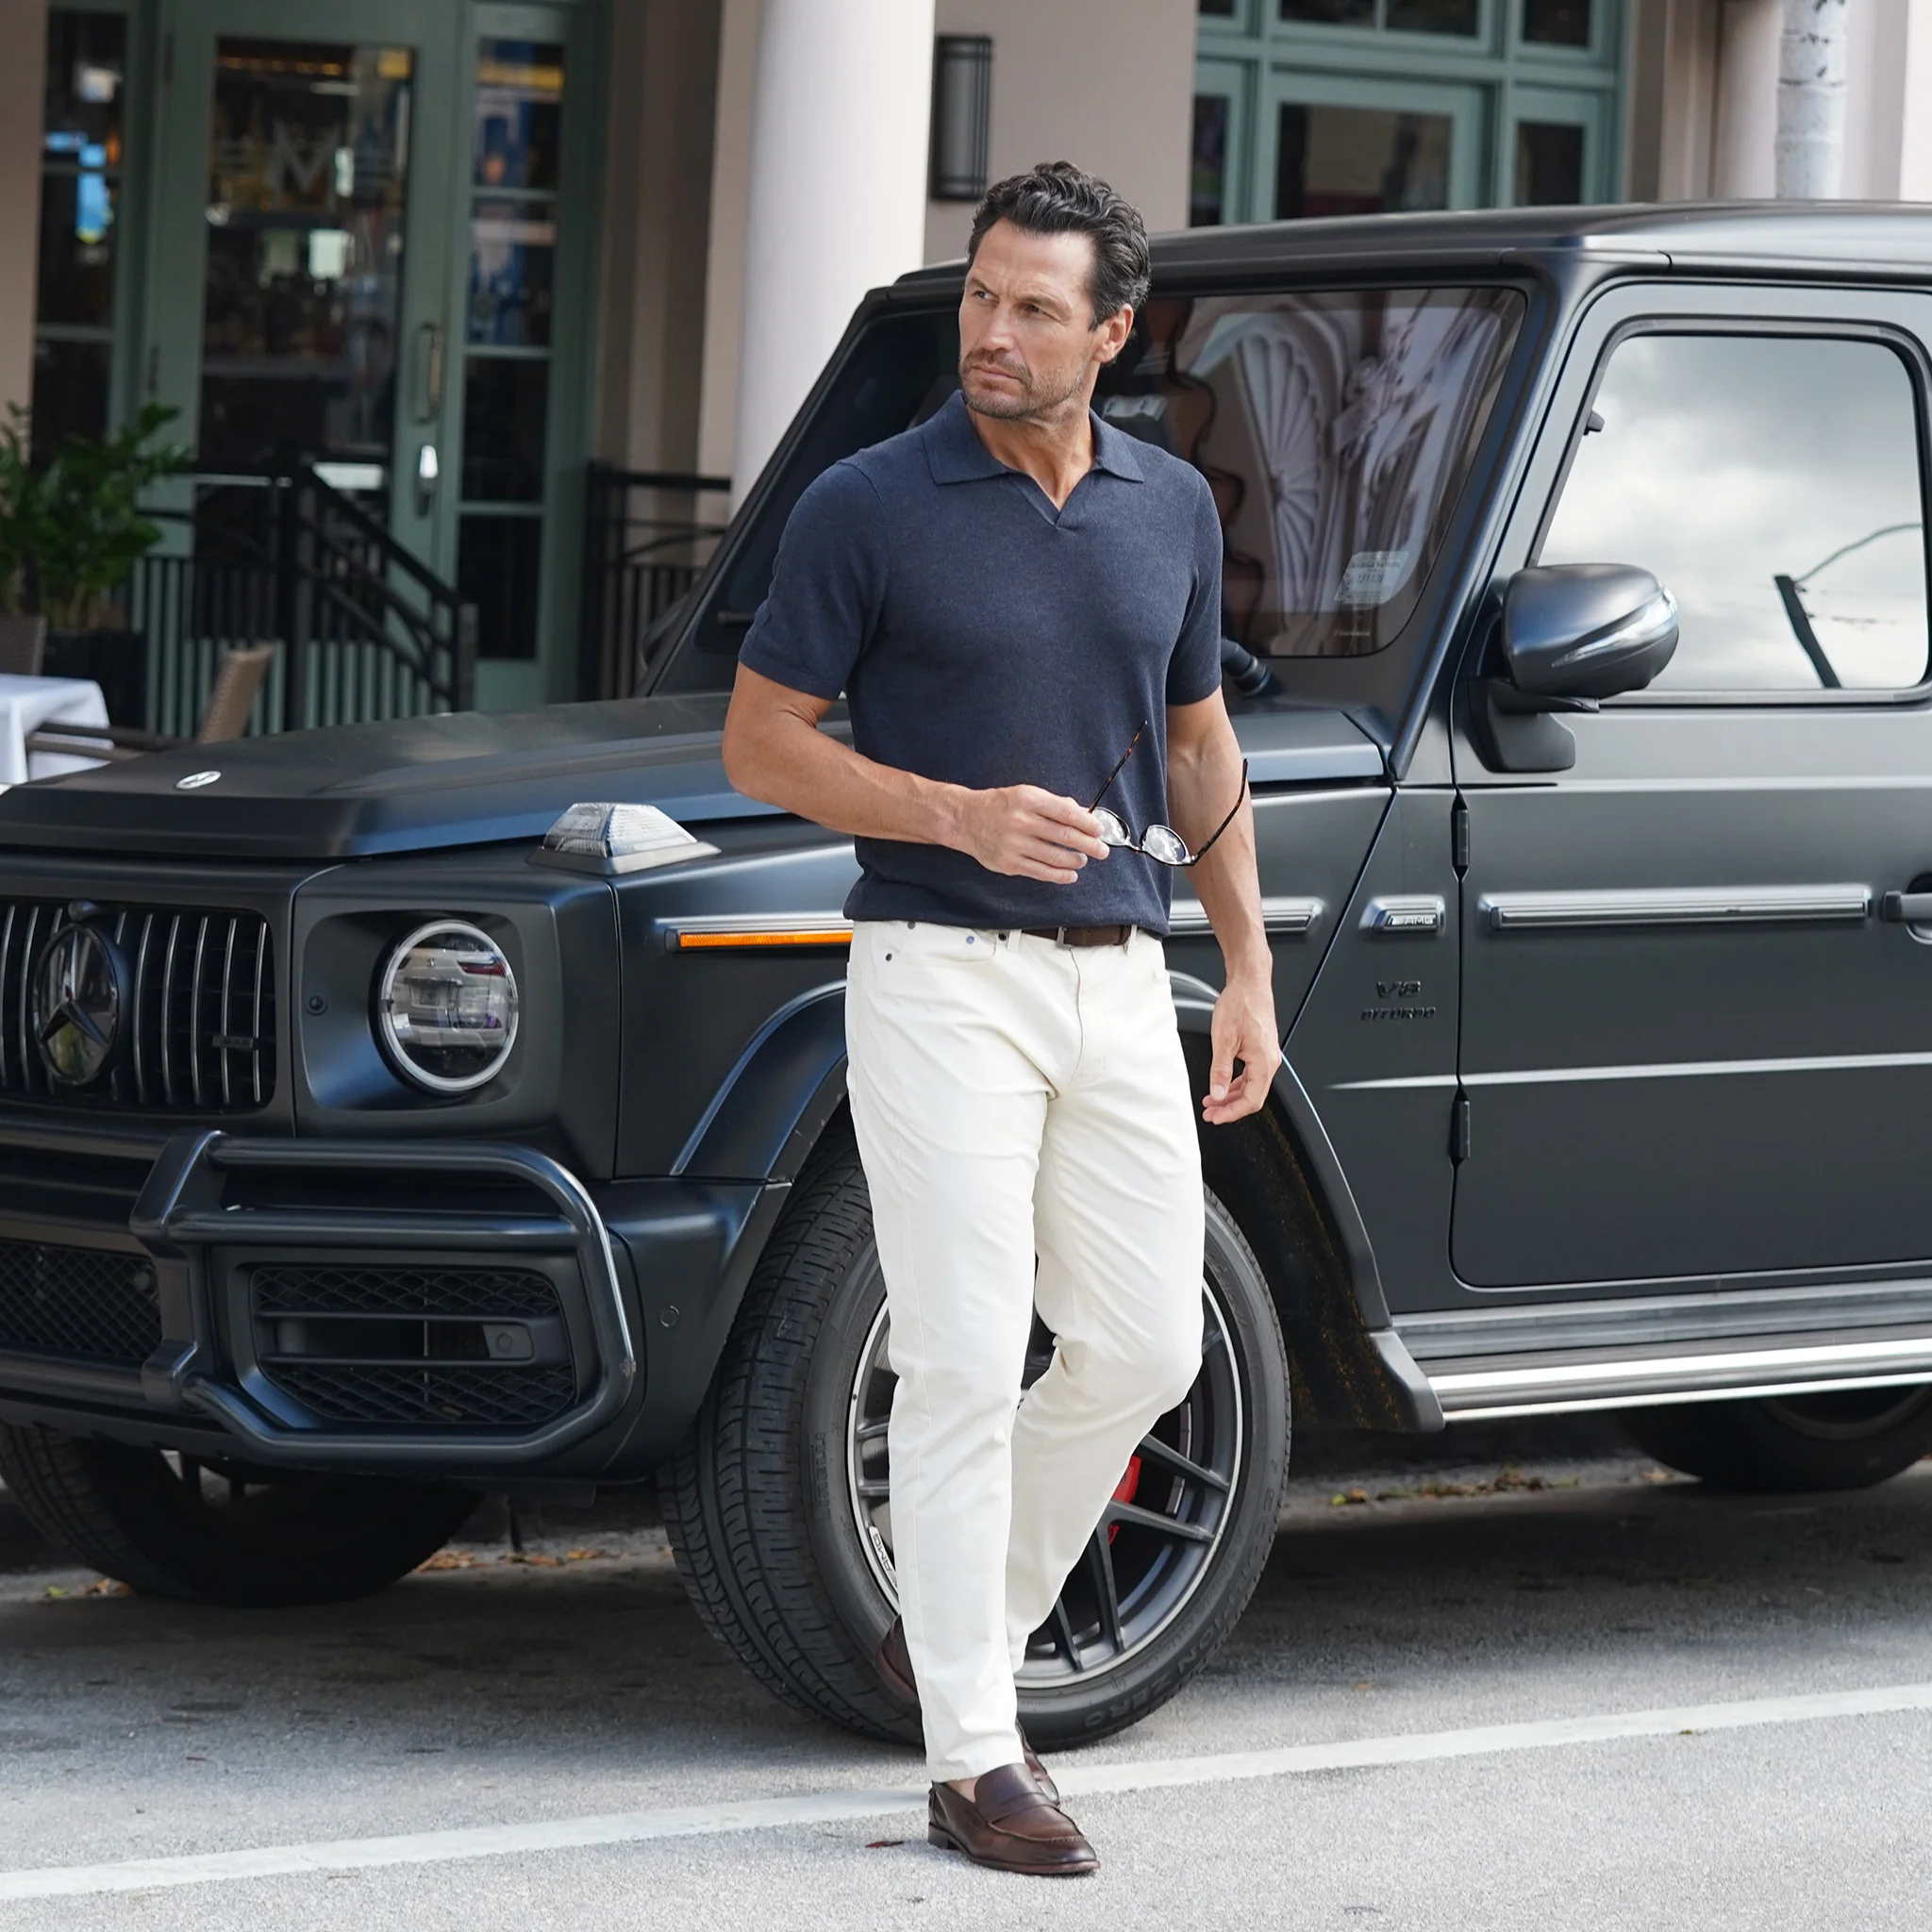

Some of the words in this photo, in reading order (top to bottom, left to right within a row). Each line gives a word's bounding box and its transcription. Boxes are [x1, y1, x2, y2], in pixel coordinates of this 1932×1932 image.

[1405, 915, 1435, 925] AMG
[1376, 980, 1422, 999] V8
[1361, 1007, 1436, 1021] BITURBO
[873, 1533, 891, 1571] AMG
[1084, 1673, 1171, 1727] ZERO
